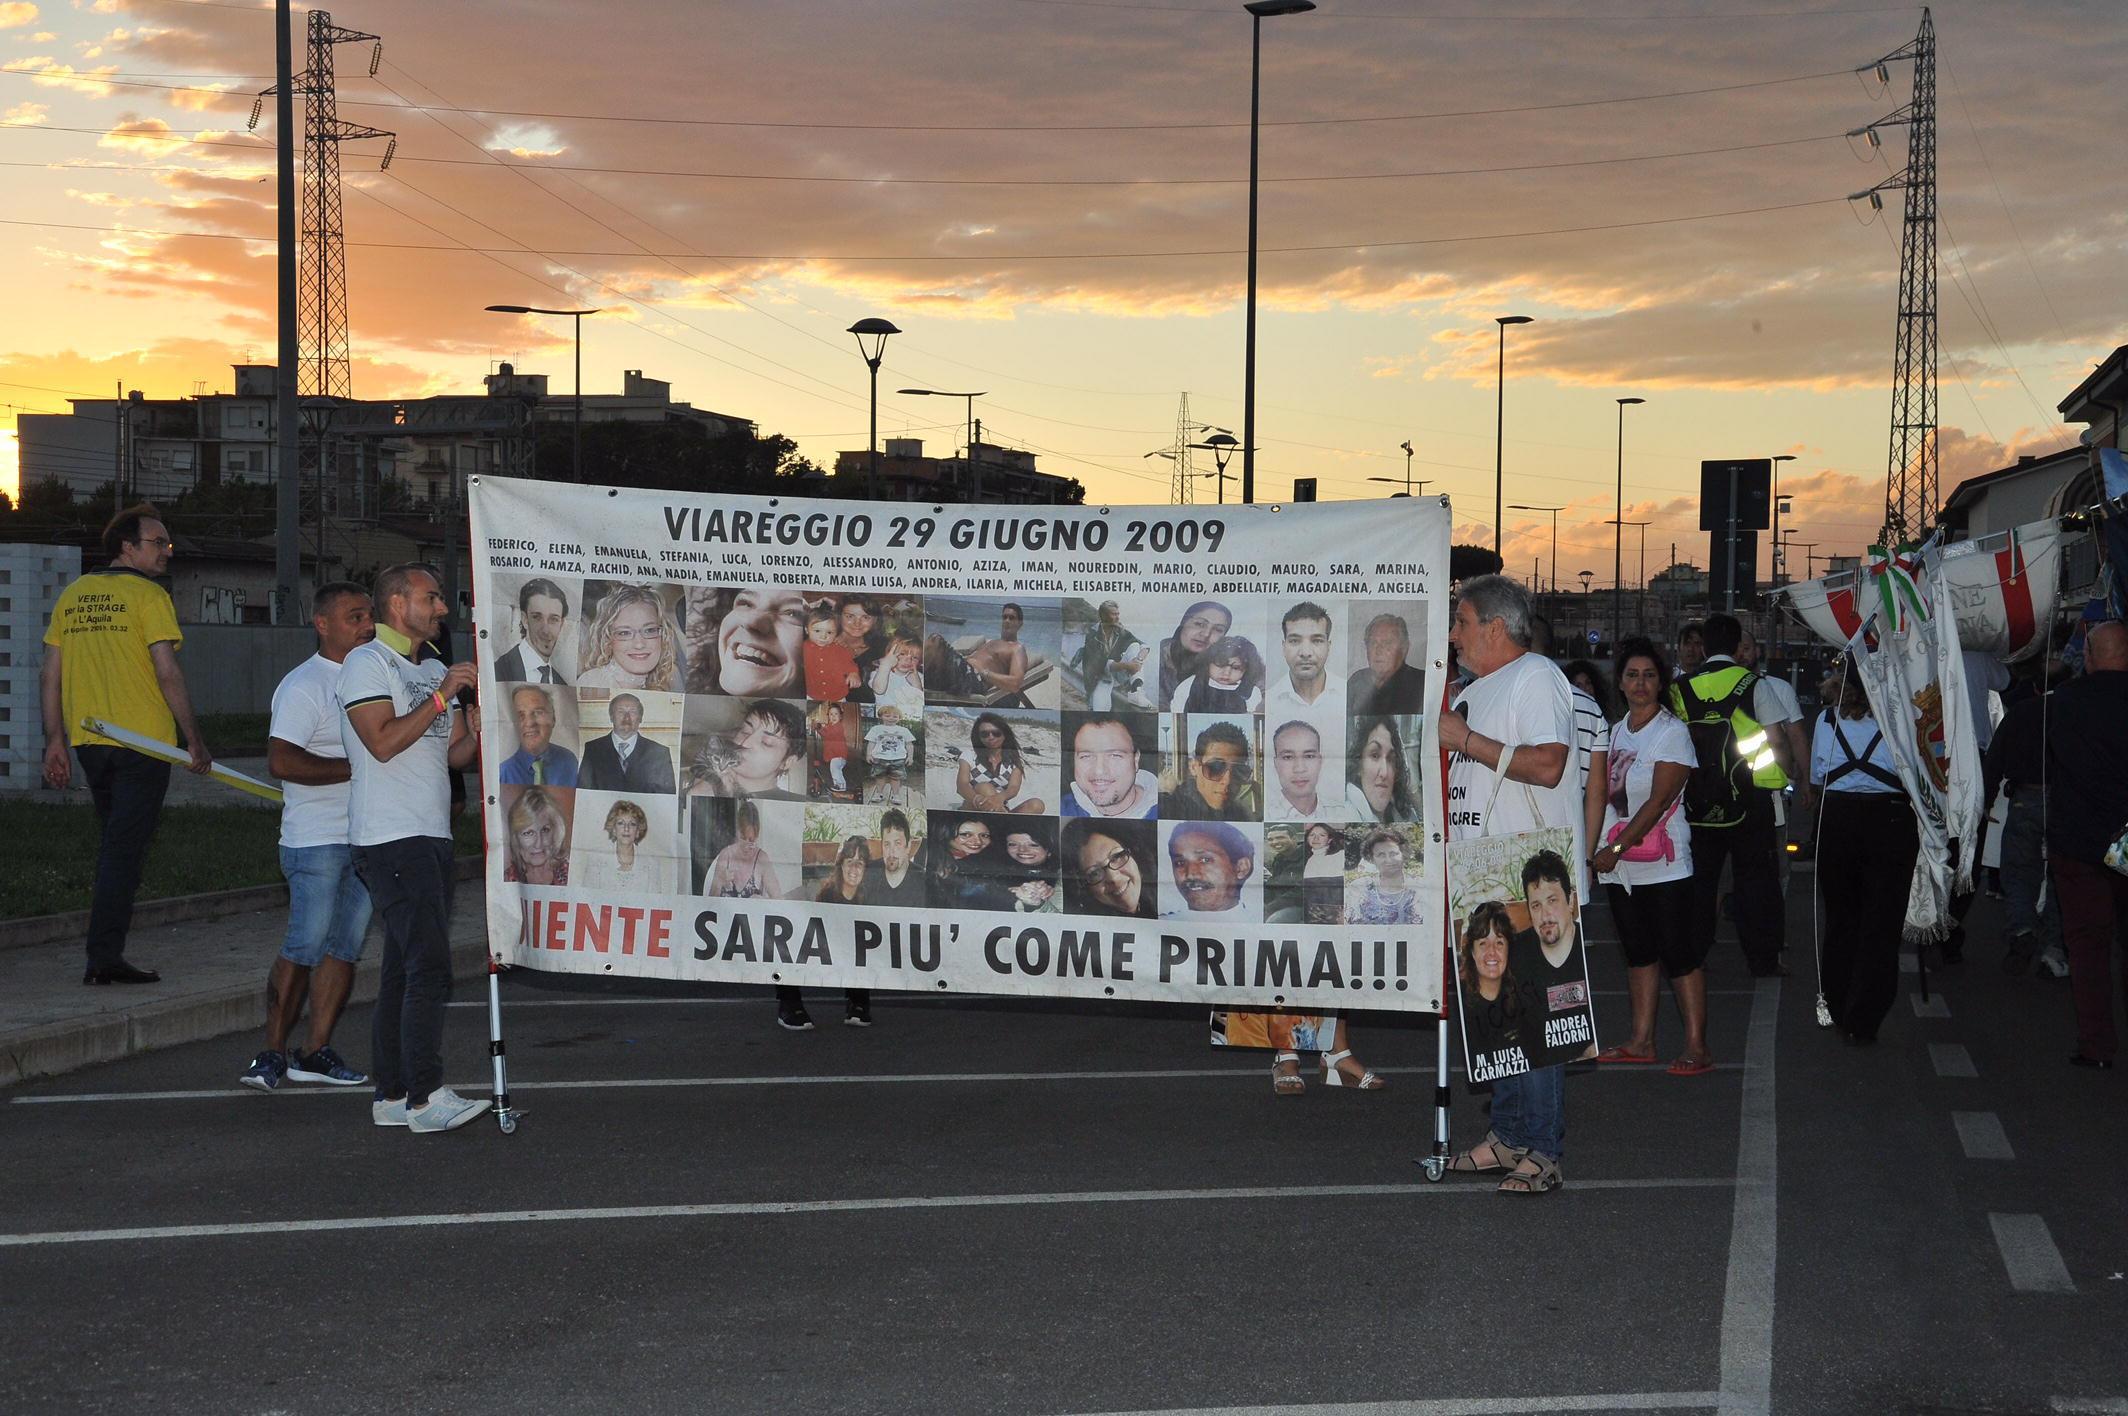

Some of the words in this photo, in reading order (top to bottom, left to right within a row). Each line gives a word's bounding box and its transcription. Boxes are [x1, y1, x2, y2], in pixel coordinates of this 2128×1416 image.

[664, 506, 873, 546] VIAREGGIO
[886, 516, 936, 547] 29
[950, 518, 1109, 551] GIUGNO
[1124, 519, 1226, 553] 2009
[488, 538, 538, 552] FEDERICO,
[549, 543, 586, 556] ELENA,
[595, 545, 652, 561] EMANUELA,
[660, 550, 713, 565] STEFANIA,
[722, 554, 751, 566] LUCA,
[761, 554, 813, 568] LORENZO,
[823, 556, 897, 570] ALESSANDRO,
[907, 558, 962, 572] ANTONIO,
[973, 560, 1011, 573] AZIZA,
[1021, 561, 1058, 574] IMAN,
[1069, 562, 1142, 575] NOUREDDIN,
[1153, 563, 1196, 576] MARIO,
[1207, 564, 1260, 577] CLAUDIO,
[1272, 564, 1319, 576] MAURO,
[1330, 564, 1364, 576] SARA,
[1376, 563, 1429, 576] MARINA,
[490, 556, 534, 570] ROSARIO,
[540, 559, 585, 574] HAMZA,
[591, 562, 633, 577] RACHID,
[637, 566, 662, 578] ANA,
[666, 568, 702, 582] NADIA,
[707, 571, 768, 584] EMANUELA,
[774, 573, 824, 587] ROBERTA,
[829, 575, 866, 587] MARIA
[871, 576, 905, 589] LUISA,
[912, 577, 961, 590] ANDREA,
[967, 579, 1008, 591] ILARIA,
[1013, 579, 1067, 592] MICHELA,
[1073, 580, 1136, 594] ELISABETH,
[1142, 581, 1207, 595] MOHAMED,
[1213, 582, 1281, 595] ABDELLATIF,
[1287, 582, 1372, 595] MAGADALENA,
[1378, 582, 1429, 594] ANGELA.
[65, 606, 76, 616] per
[77, 604, 84, 613] la
[87, 603, 127, 613] STRAGE
[78, 594, 114, 603] VERITA'
[78, 614, 112, 625] L'Aquila
[1448, 812, 1481, 826] ICARE
[693, 909, 833, 965] SARA
[853, 919, 960, 972] PIU'
[984, 925, 1135, 980] COME
[1159, 934, 1408, 991] PRIMA!!!
[1544, 1013, 1589, 1035] ANDREA
[1545, 1027, 1591, 1049] FALORNI
[1475, 1053, 1491, 1068] M.
[1493, 1046, 1525, 1065] LUISA
[1473, 1058, 1531, 1083] CARMAZZI
